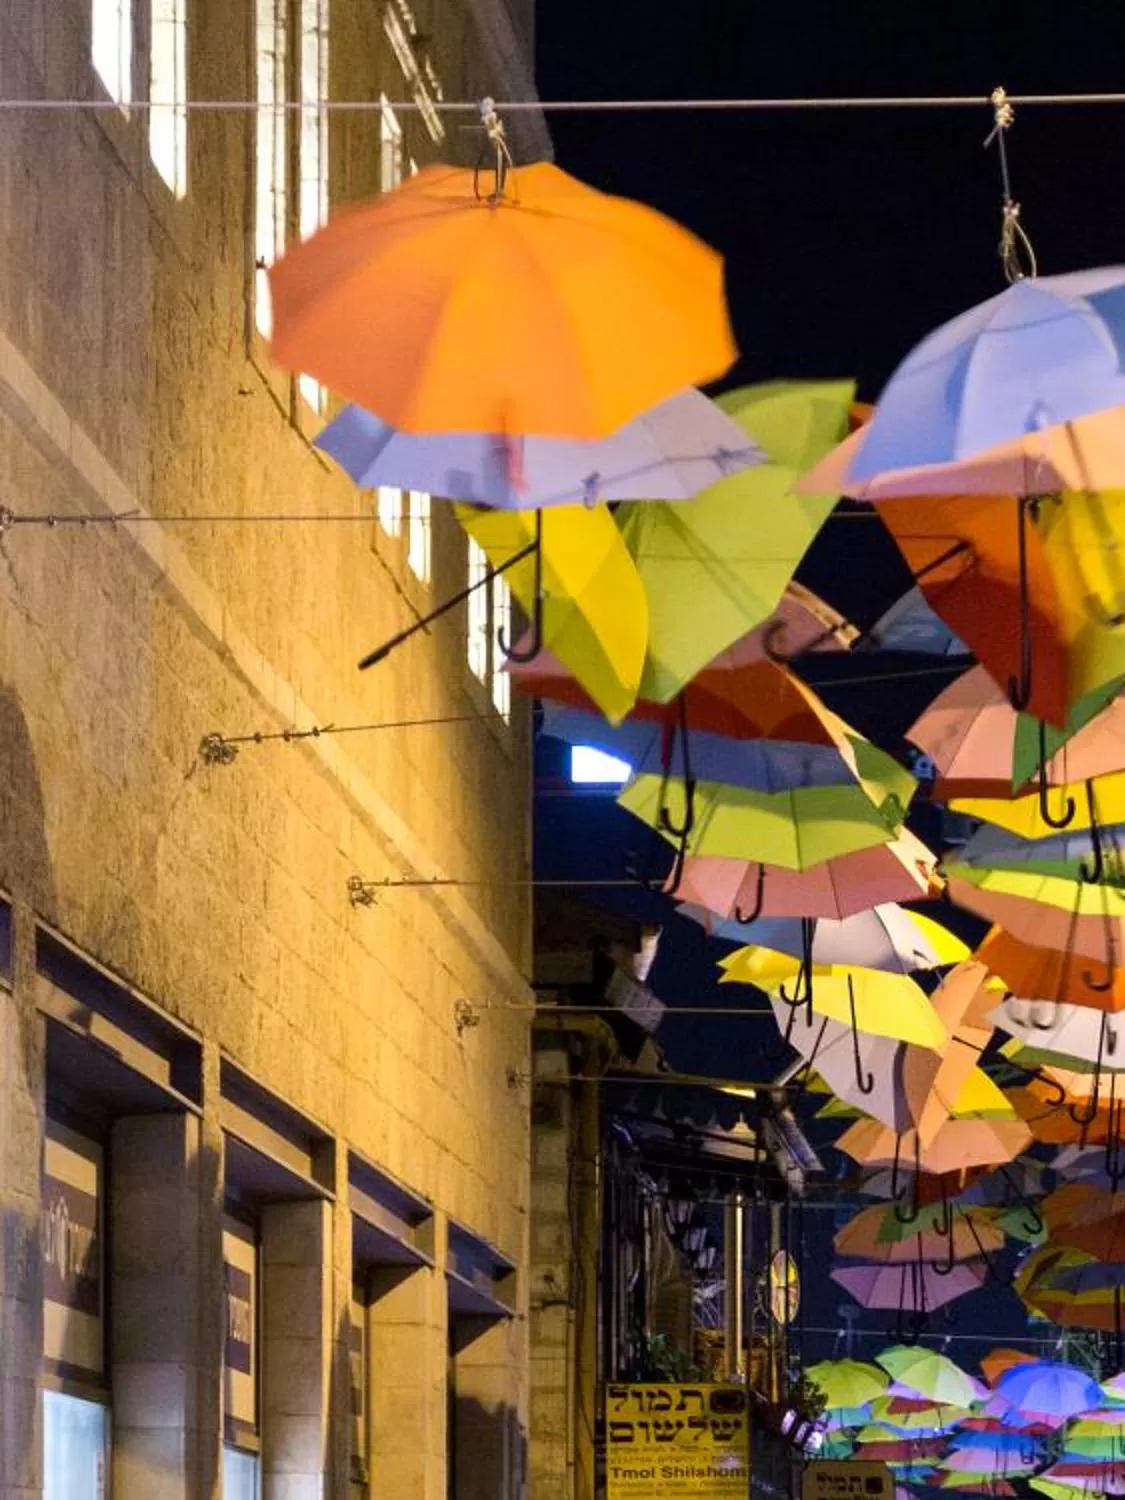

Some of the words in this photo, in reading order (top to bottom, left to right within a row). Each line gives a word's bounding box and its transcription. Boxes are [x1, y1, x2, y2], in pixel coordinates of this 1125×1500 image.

[609, 1387, 705, 1412] תמול
[609, 1415, 742, 1443] שלשום
[610, 1466, 655, 1479] Tmol
